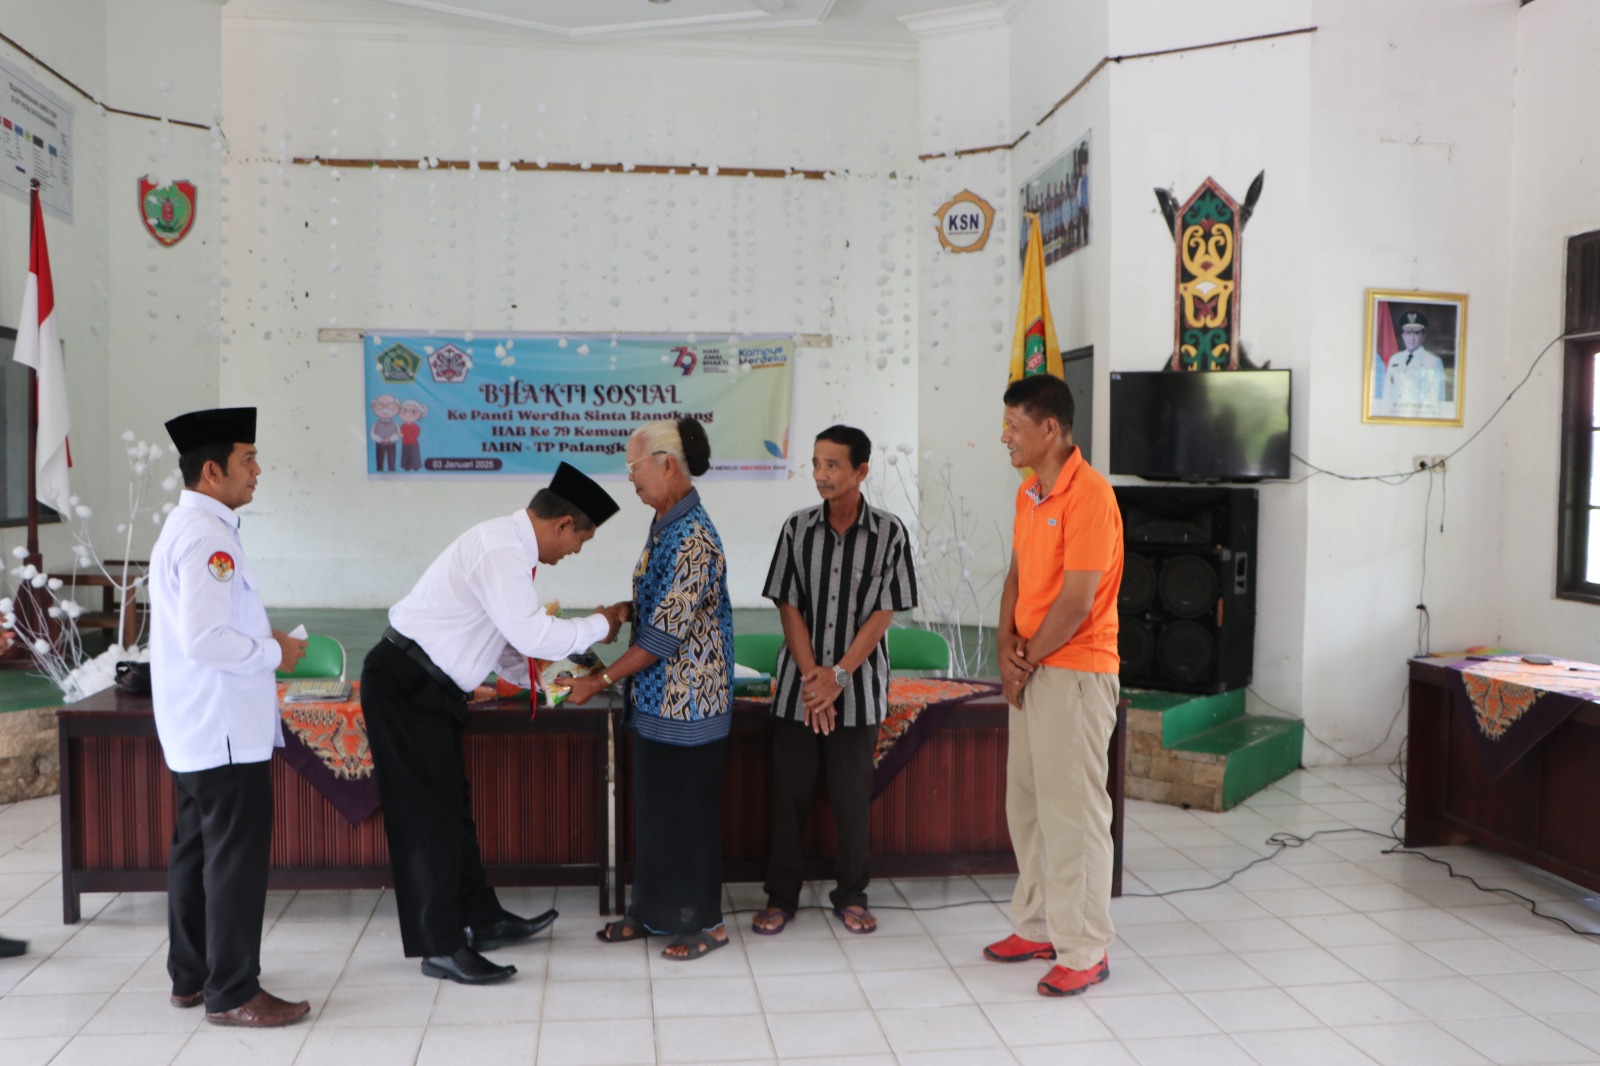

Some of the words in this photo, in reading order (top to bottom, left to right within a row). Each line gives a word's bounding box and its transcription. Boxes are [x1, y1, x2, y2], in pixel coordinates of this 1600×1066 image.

[949, 213, 979, 231] KSN
[738, 346, 783, 358] Kampus
[738, 355, 787, 366] Merdeka
[479, 380, 586, 407] BHAKTI
[592, 384, 683, 406] SOSIAL
[447, 410, 467, 420] Ke
[471, 410, 513, 420] Panti
[517, 410, 580, 420] Werdha
[584, 410, 626, 420] Sinta
[492, 426, 526, 437] HAB
[530, 426, 550, 437] Ke
[553, 426, 571, 437] 79
[481, 442, 522, 452] IAHN
[534, 442, 555, 452] TP
[432, 460, 443, 469] 03
[444, 460, 474, 469] Januari
[475, 460, 495, 469] 2025
